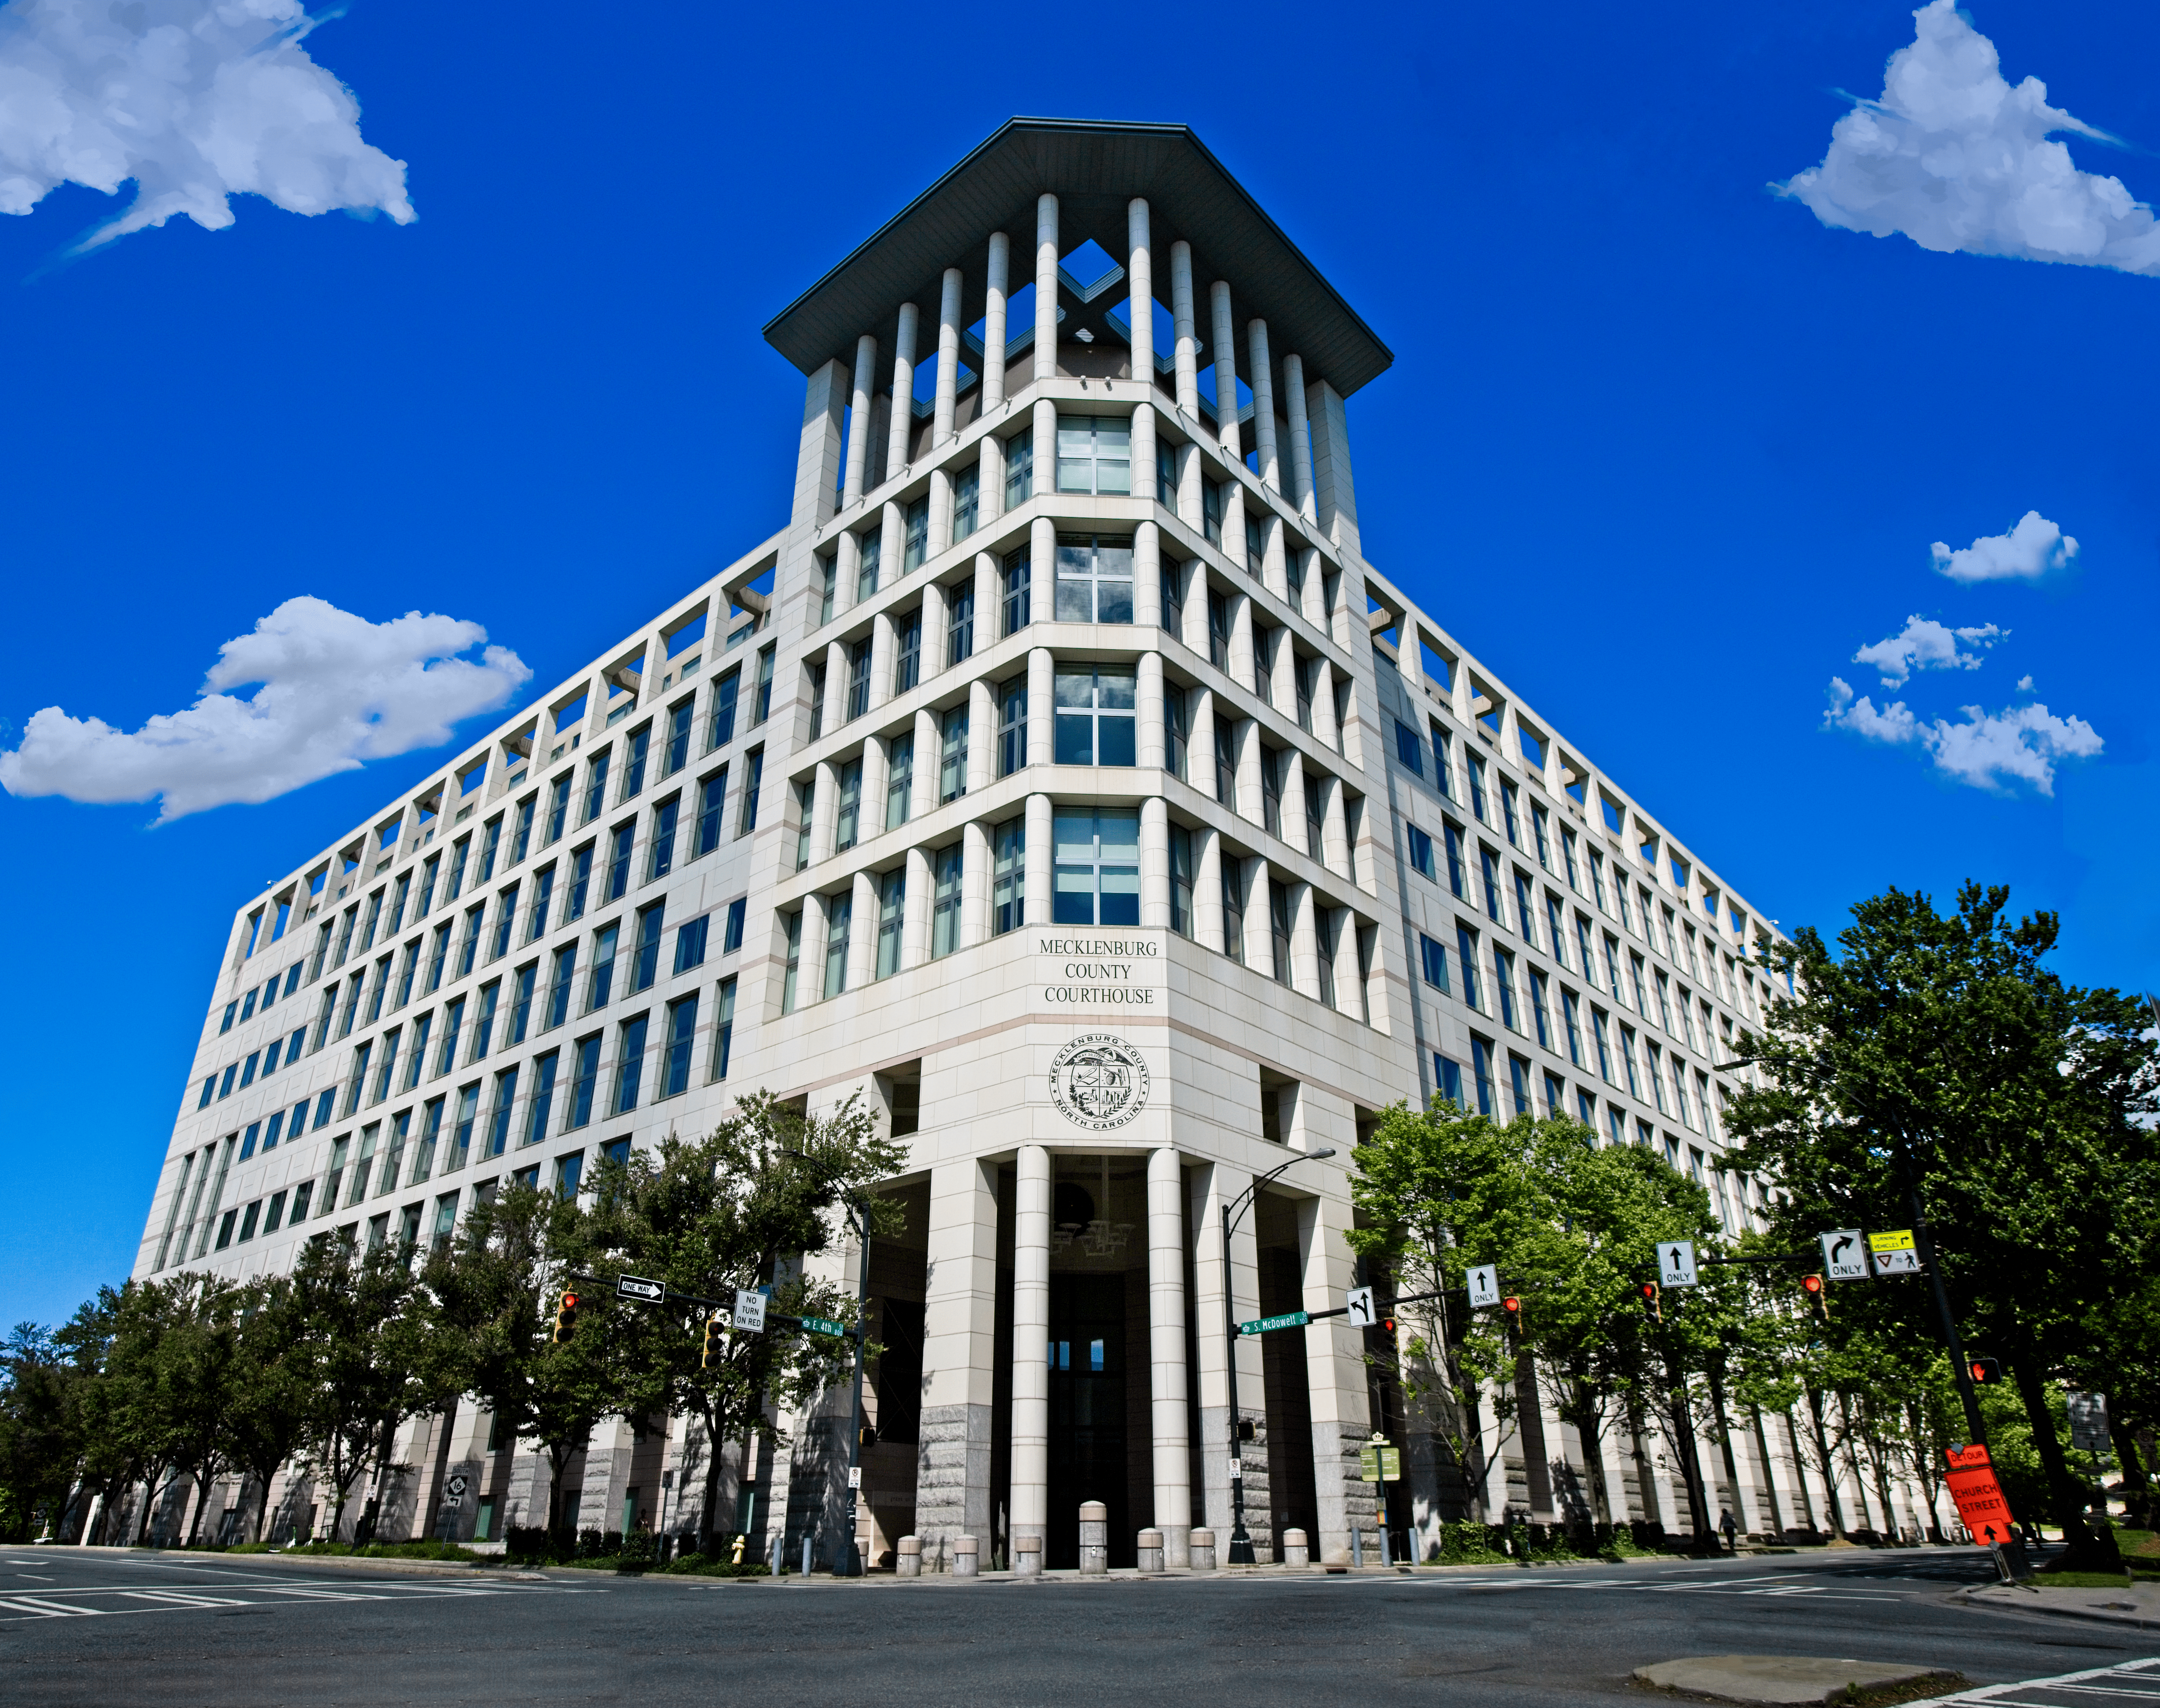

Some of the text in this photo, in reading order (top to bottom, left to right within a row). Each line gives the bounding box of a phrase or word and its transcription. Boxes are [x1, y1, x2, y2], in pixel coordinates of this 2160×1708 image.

[1040, 940, 1157, 956] MECKLENBURG
[1065, 964, 1131, 979] COUNTY
[1045, 987, 1153, 1003] COURTHOUSE
[1051, 1036, 1148, 1085] MECKLENBURG COUNTY
[1056, 1099, 1144, 1129] NORTH CAROLINA
[1833, 1264, 1861, 1275] ONLY
[1667, 1272, 1690, 1282] ONLY
[623, 1282, 636, 1291] ONE
[746, 1295, 756, 1304] NO
[1475, 1293, 1493, 1303] ONLY
[743, 1306, 759, 1316] TURN
[737, 1316, 761, 1327] ON RED
[813, 1320, 818, 1330] E.
[821, 1322, 831, 1333] 4th
[1254, 1322, 1260, 1331] S.
[1262, 1315, 1296, 1329] McDowell
[1951, 1451, 1985, 1462] DETOUR
[454, 1481, 461, 1490] 16
[1954, 1484, 1999, 1499] CHURCH
[1961, 1499, 2002, 1513] STREET
